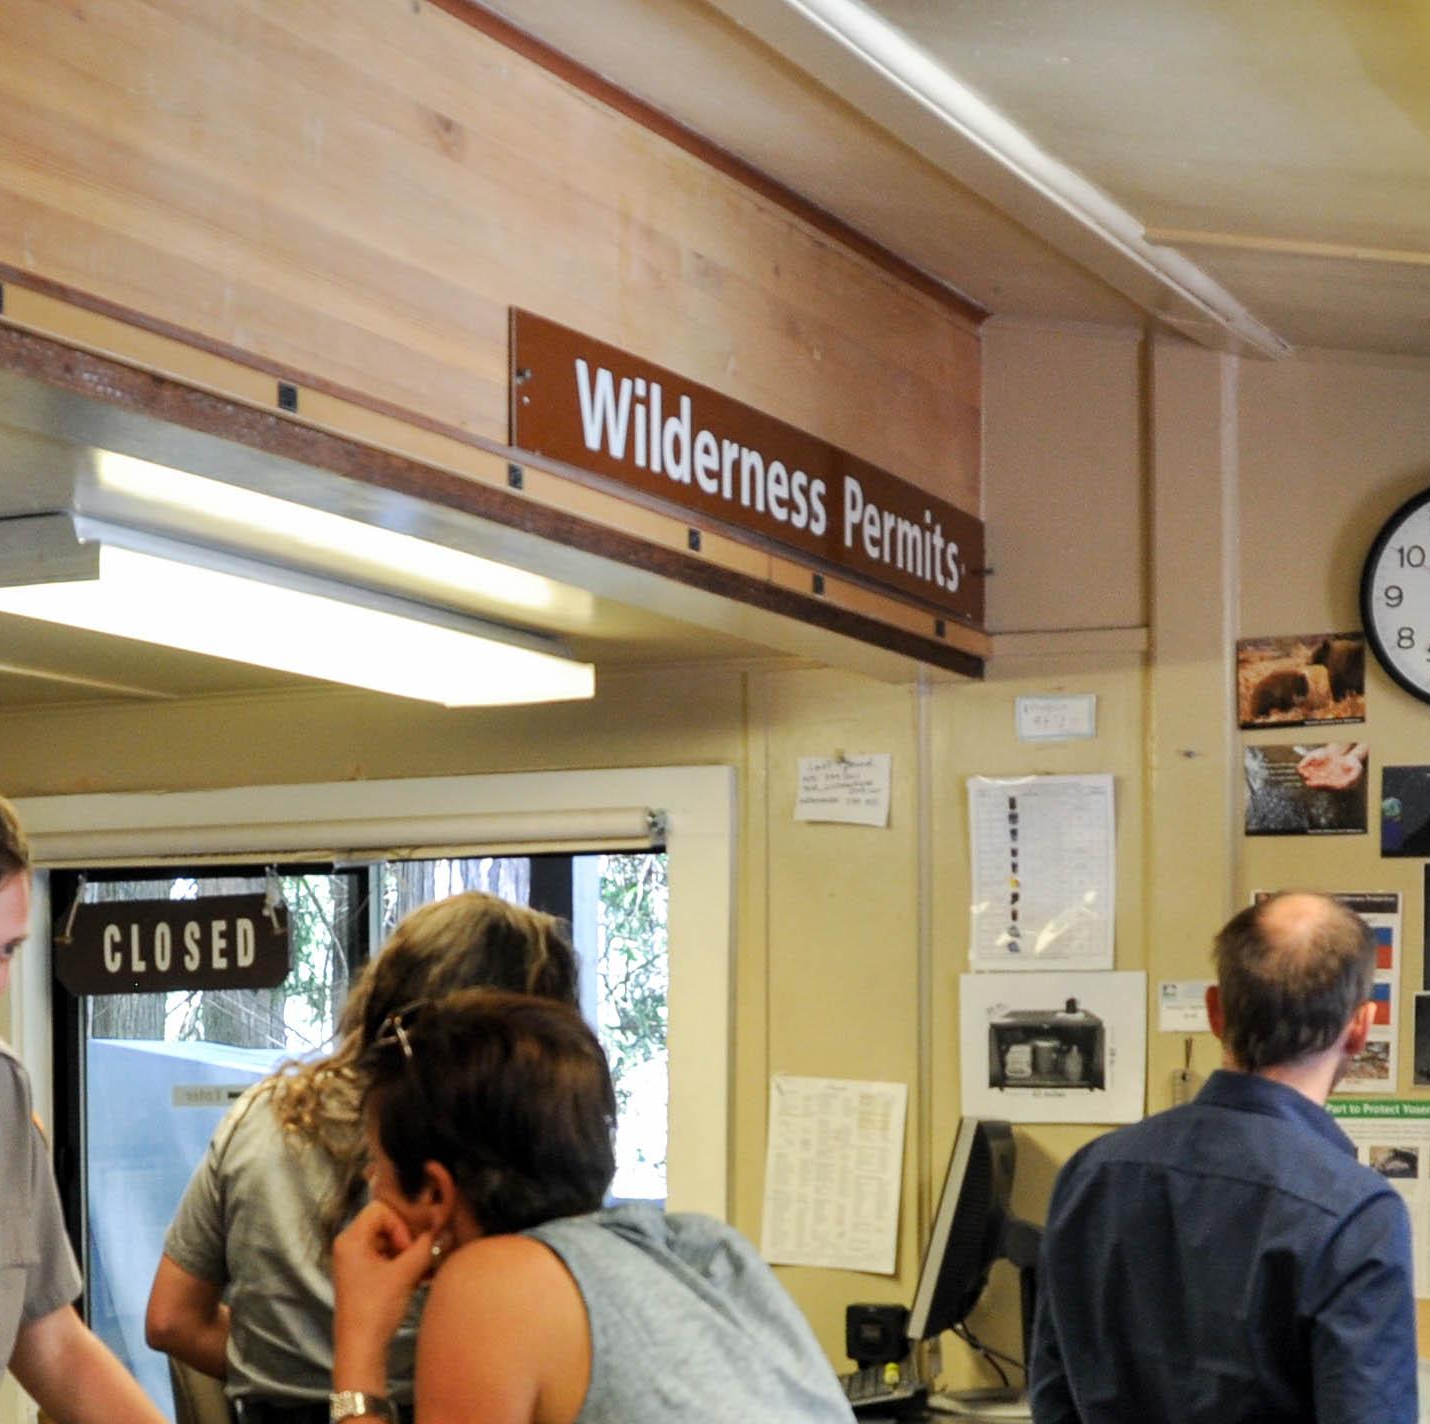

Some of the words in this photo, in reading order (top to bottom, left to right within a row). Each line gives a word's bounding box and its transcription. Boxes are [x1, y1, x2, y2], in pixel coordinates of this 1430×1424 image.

[575, 358, 827, 537] Wilderness
[843, 475, 960, 593] Permits
[1397, 544, 1426, 568] 10
[1383, 585, 1404, 608] 9
[1396, 626, 1415, 649] 8
[103, 917, 255, 973] CLOSED
[1350, 1103, 1361, 1115] to
[1363, 1103, 1401, 1115] Protect
